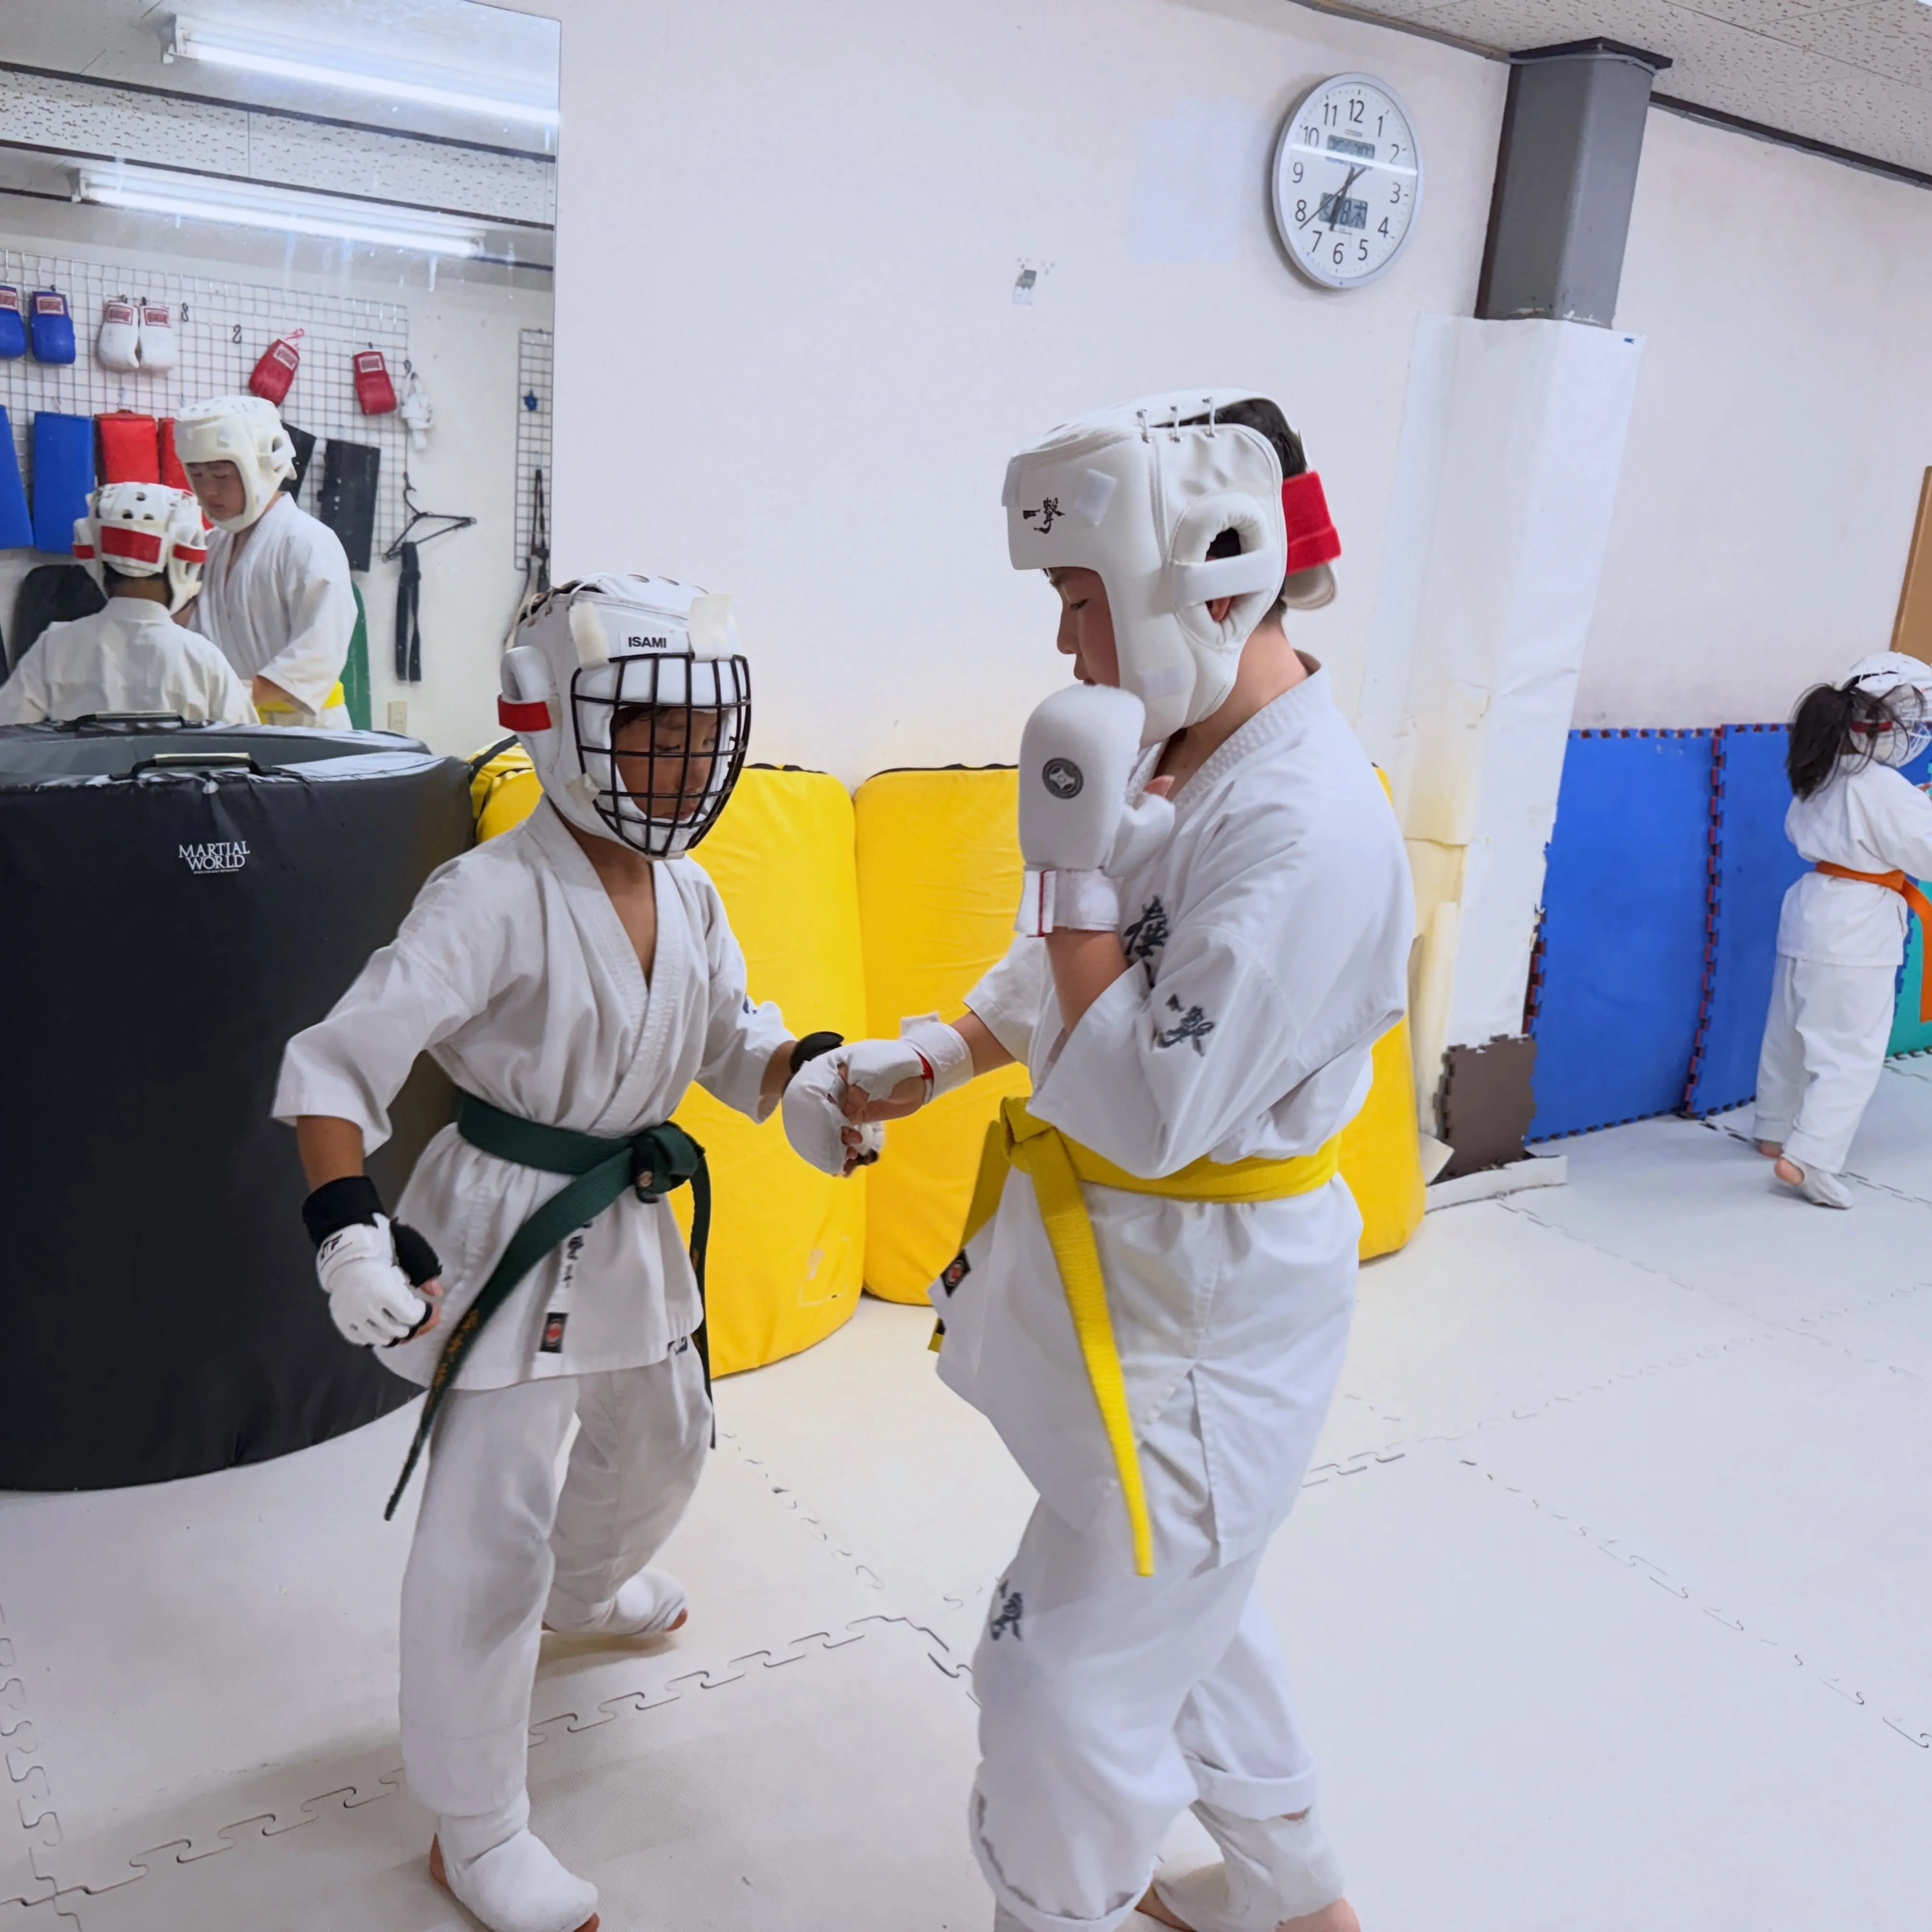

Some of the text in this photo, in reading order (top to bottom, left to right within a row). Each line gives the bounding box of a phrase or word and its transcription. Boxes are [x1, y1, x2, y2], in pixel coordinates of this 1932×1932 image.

[1323, 103, 1338, 127] 11
[1349, 99, 1365, 124] 12
[1303, 125, 1319, 148] 10
[1378, 115, 1383, 138] 1
[1390, 144, 1400, 165] 2
[1292, 162, 1304, 183] 9
[1390, 183, 1401, 204] 3
[1295, 199, 1307, 221] 8
[1378, 217, 1390, 238] 4
[1311, 230, 1322, 253] 7
[1357, 239, 1369, 261] 5
[1333, 242, 1345, 264] 6
[628, 636, 667, 648] ISAMI
[178, 840, 251, 858] MARTIAL
[186, 854, 246, 871] WORLD
